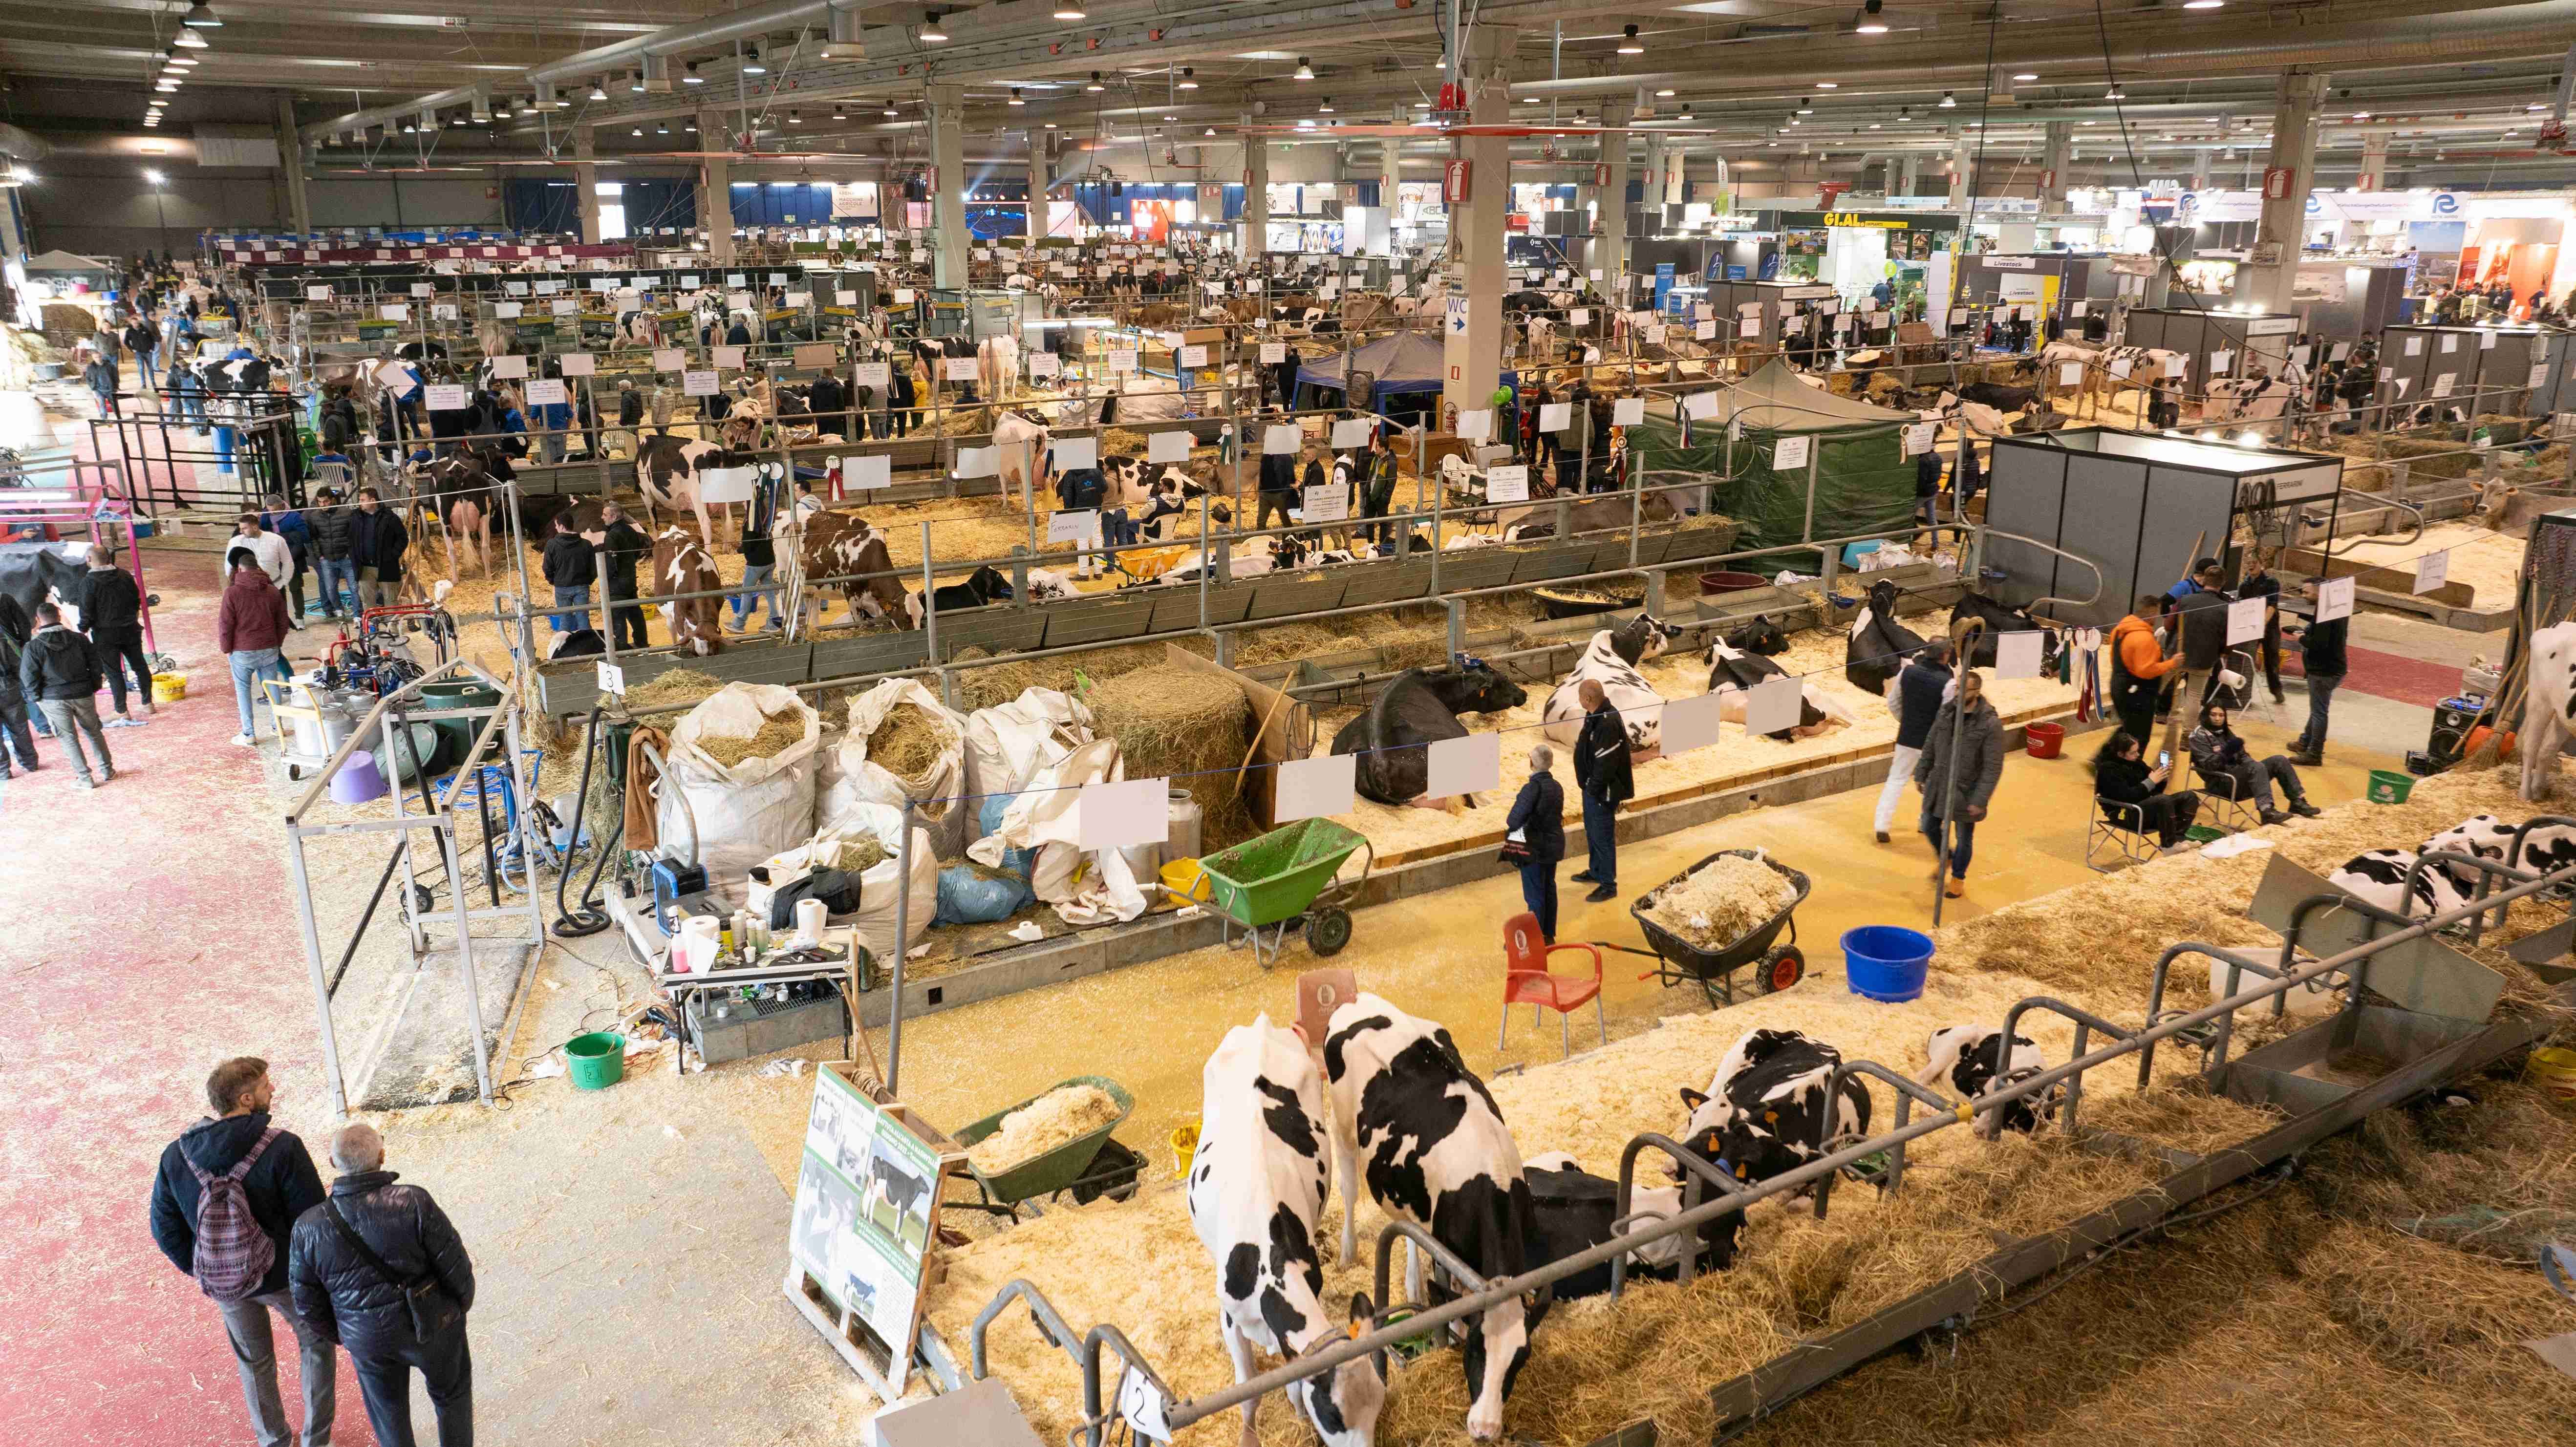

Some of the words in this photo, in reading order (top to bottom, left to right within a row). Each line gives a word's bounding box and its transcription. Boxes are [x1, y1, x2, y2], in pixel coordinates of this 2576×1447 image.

[1824, 213, 1865, 227] GI.AL.
[1448, 298, 1467, 314] WC
[606, 670, 614, 687] 3
[1133, 1386, 1146, 1426] 2
